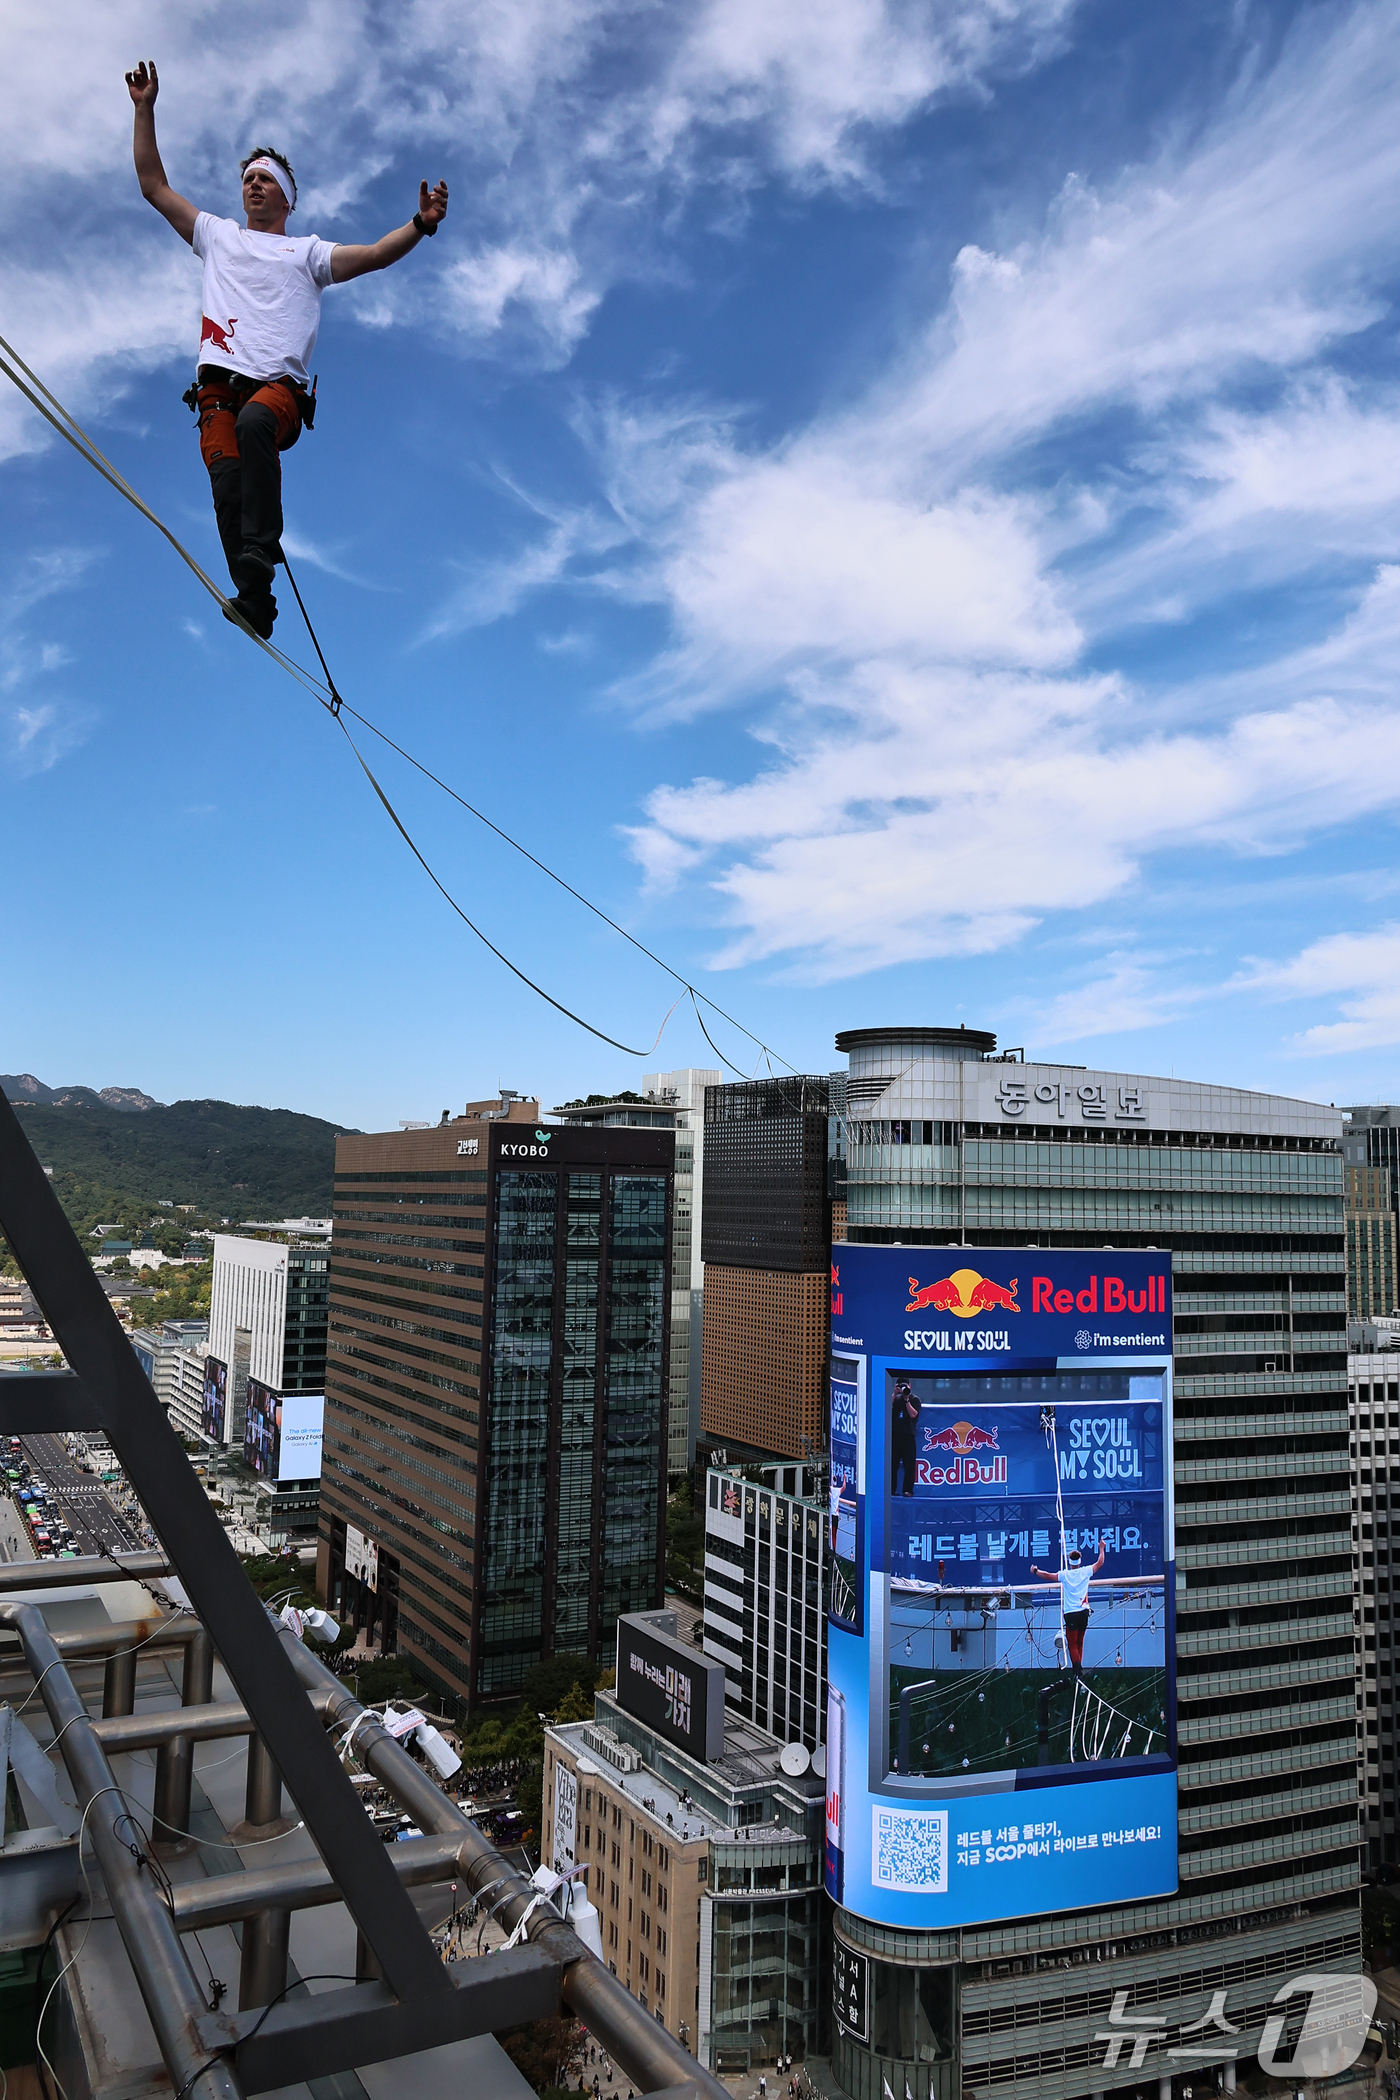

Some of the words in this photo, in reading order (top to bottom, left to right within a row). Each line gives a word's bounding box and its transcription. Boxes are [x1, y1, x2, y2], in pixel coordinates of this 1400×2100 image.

[995, 1080, 1147, 1119] 동아일보
[501, 1144, 549, 1157] KYOBO
[1032, 1275, 1097, 1313] Red
[1104, 1275, 1165, 1313] Bull
[840, 1336, 863, 1346] sentient
[977, 1330, 1011, 1351] SOUL
[1093, 1332, 1111, 1346] i'm
[1112, 1332, 1165, 1346] sentient
[914, 1457, 961, 1485] Red
[963, 1455, 1008, 1485] Bull
[1093, 1448, 1142, 1478] SOUL
[745, 1496, 828, 1538] 광화문우체
[908, 1533, 979, 1562] 레드불
[987, 1529, 1051, 1559] 날개를
[1058, 1526, 1149, 1553] 펼쳐줘요.
[630, 1652, 644, 1675] 함께
[644, 1662, 666, 1690] 누리는
[665, 1664, 691, 1706] 미래
[664, 1692, 691, 1735] 가치
[956, 1829, 993, 1847] 레드불
[996, 1827, 1020, 1843] 서울
[1023, 1821, 1062, 1839] 줄타기,
[956, 1850, 981, 1866] 지금
[1053, 1834, 1099, 1854] 라이브로
[1101, 1825, 1162, 1847] 만나보세요!
